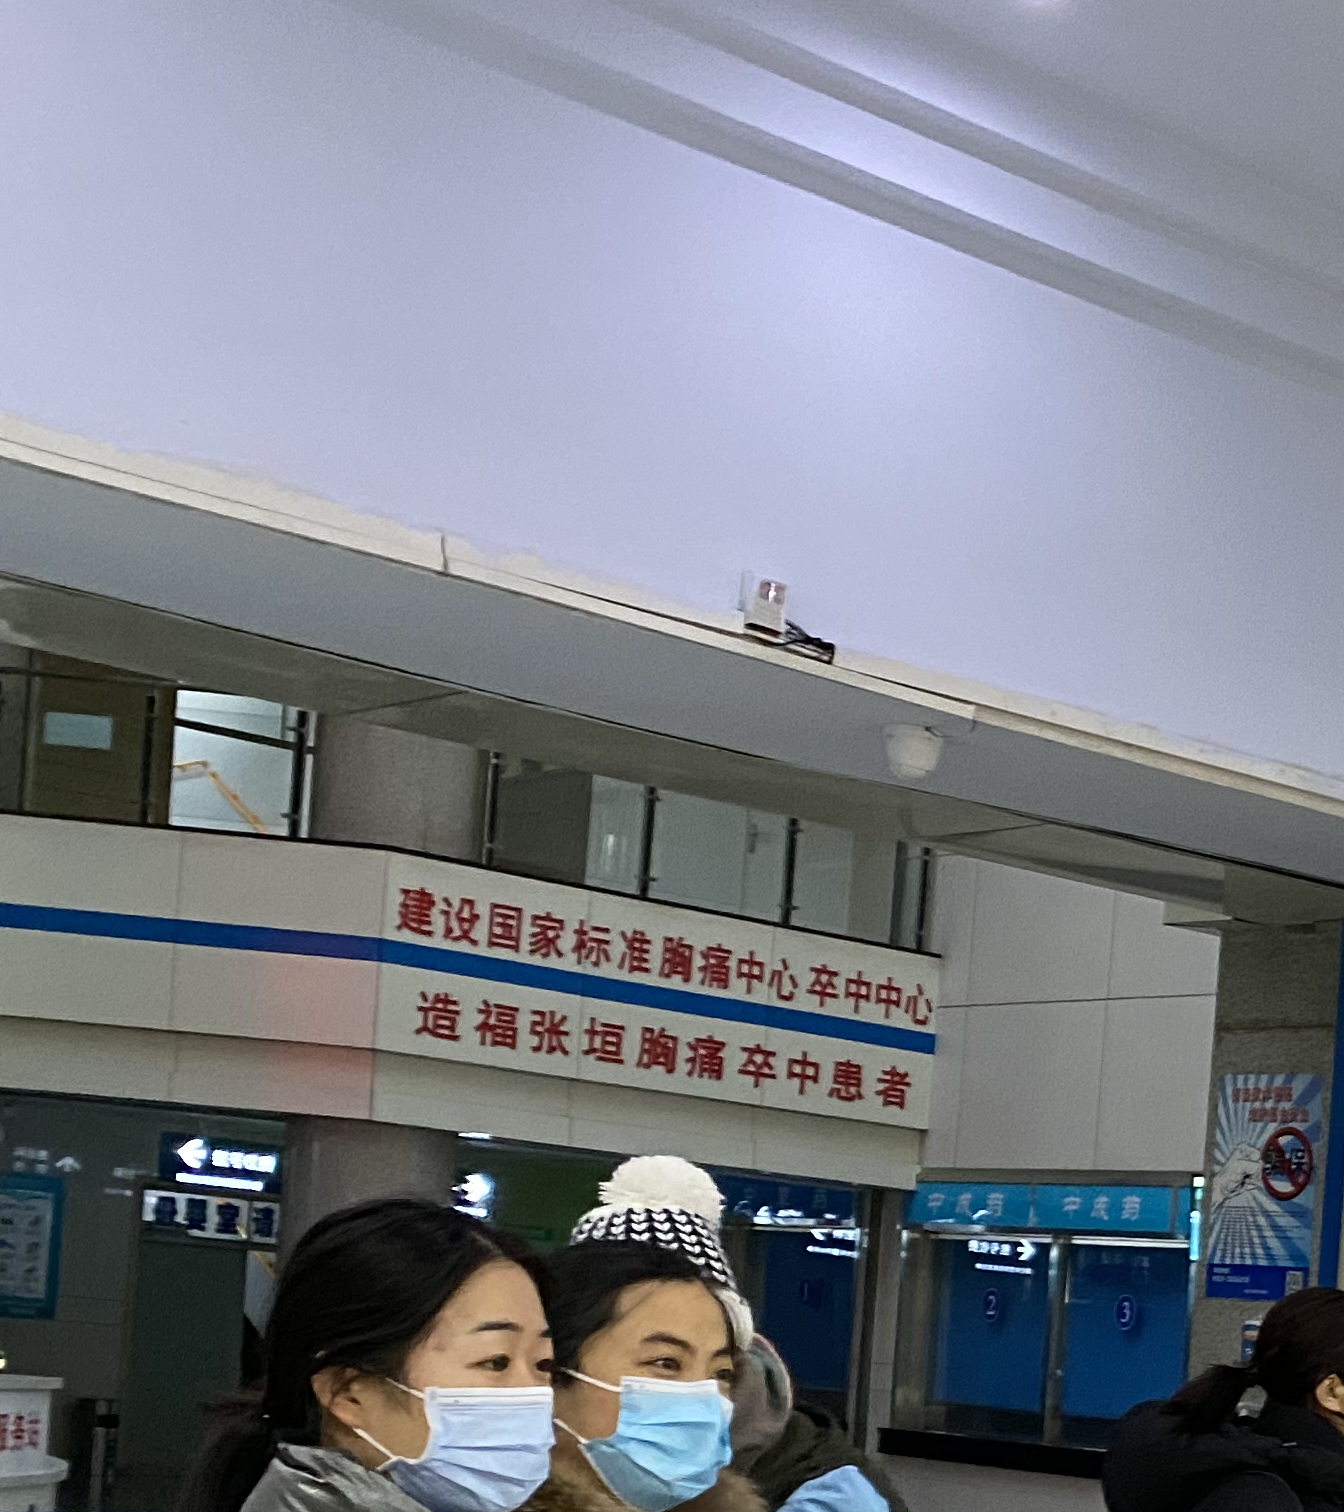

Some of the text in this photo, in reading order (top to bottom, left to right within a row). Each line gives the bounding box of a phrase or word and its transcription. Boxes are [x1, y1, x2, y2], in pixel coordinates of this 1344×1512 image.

[414, 991, 912, 1111] 造福张垣胸痛卒中患者
[985, 1295, 997, 1316] 2
[1119, 1301, 1132, 1323] 3
